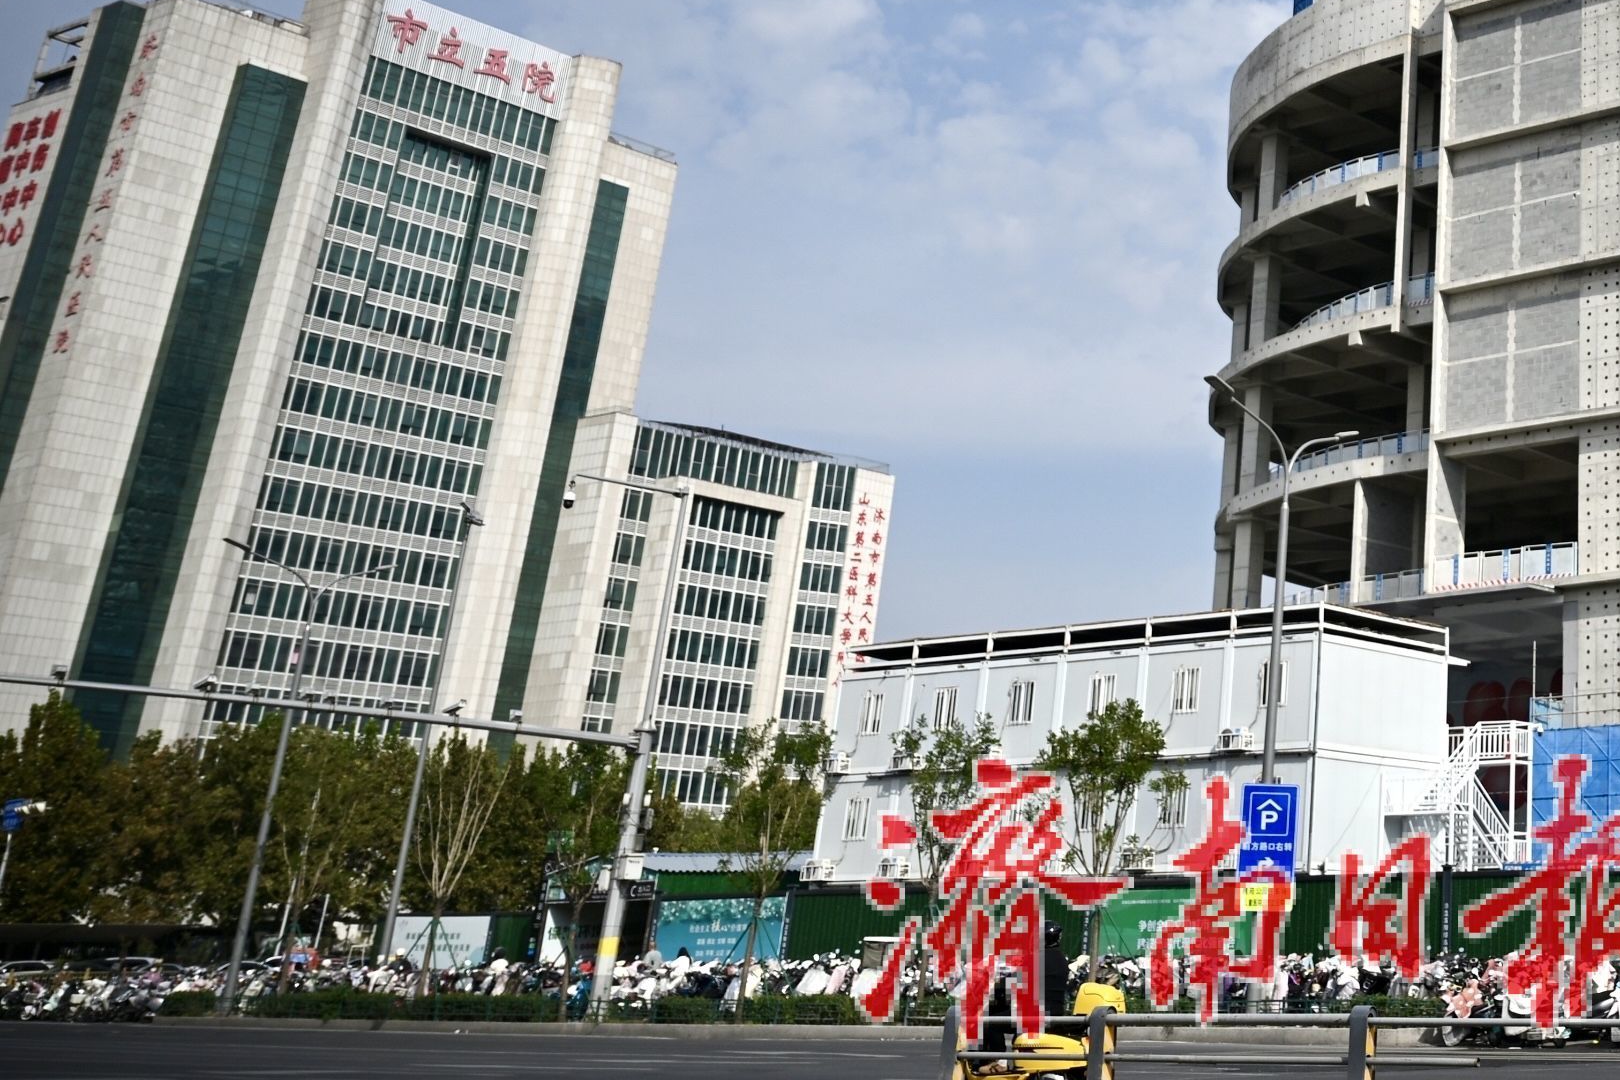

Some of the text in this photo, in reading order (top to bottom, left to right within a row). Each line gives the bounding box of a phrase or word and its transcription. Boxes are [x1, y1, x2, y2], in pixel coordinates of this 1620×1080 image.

[387, 8, 555, 104] 市立五院
[1261, 810, 1279, 831] P
